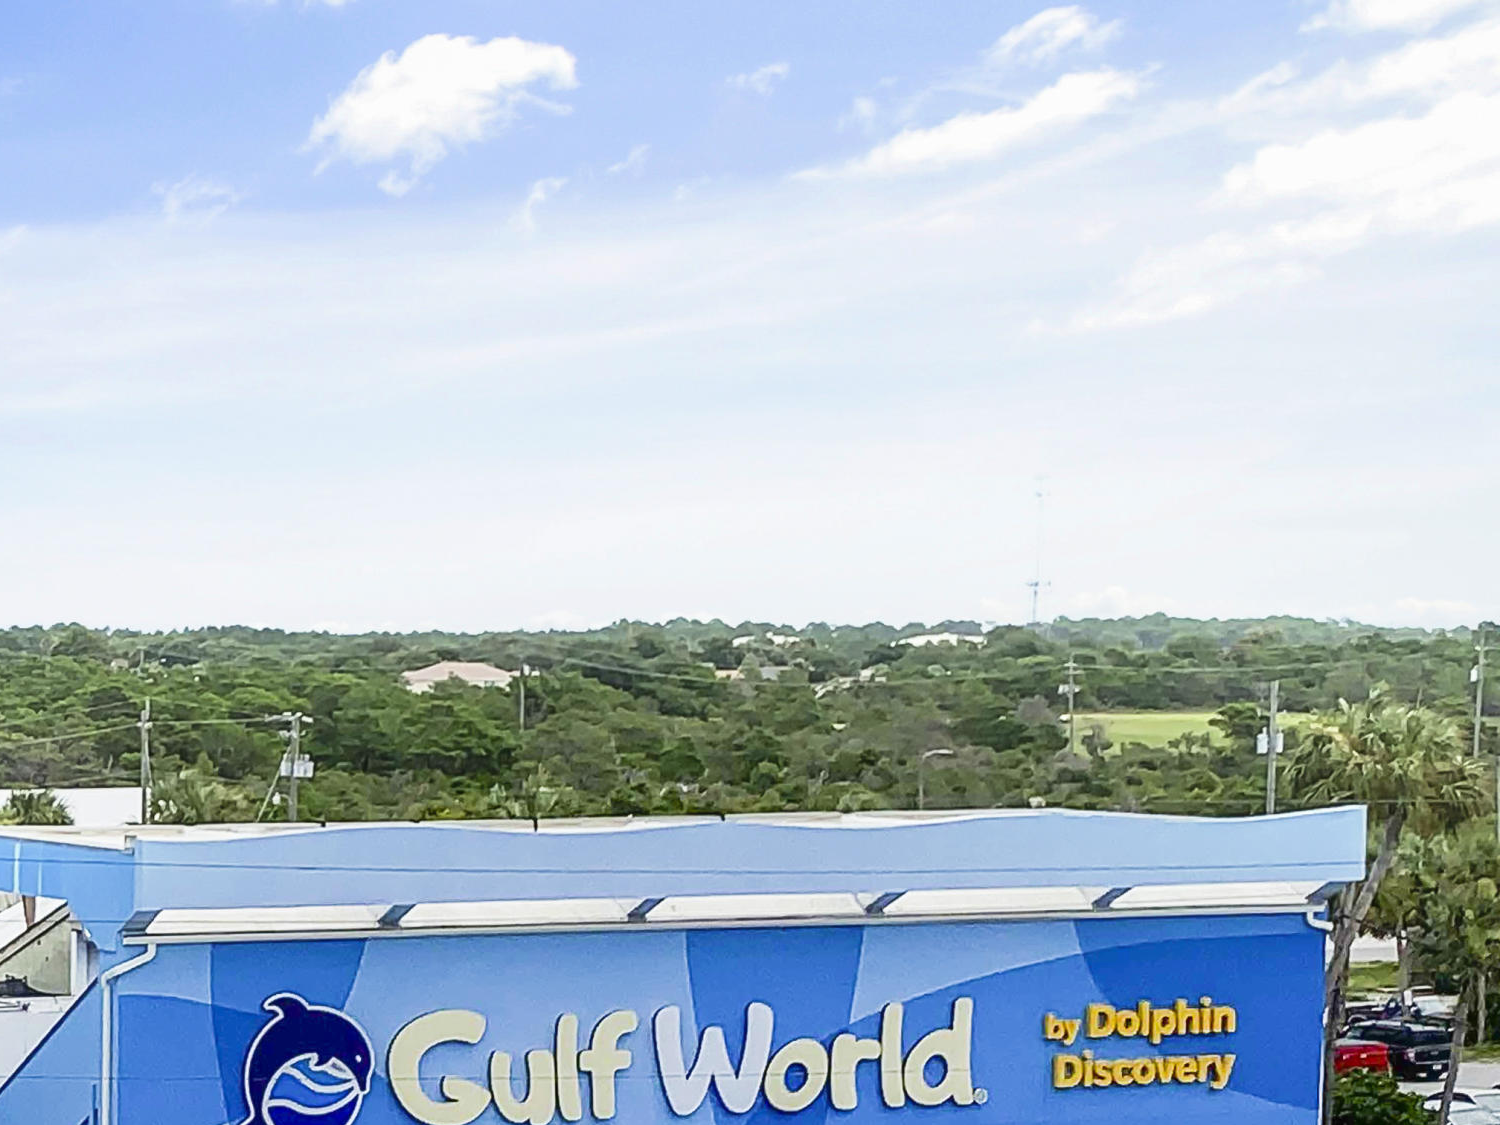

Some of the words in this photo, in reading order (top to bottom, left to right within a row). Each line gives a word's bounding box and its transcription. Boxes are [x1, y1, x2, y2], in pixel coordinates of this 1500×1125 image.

[1043, 1011, 1082, 1047] by
[1086, 995, 1238, 1045] Dolphin
[1053, 1048, 1237, 1091] Discovery
